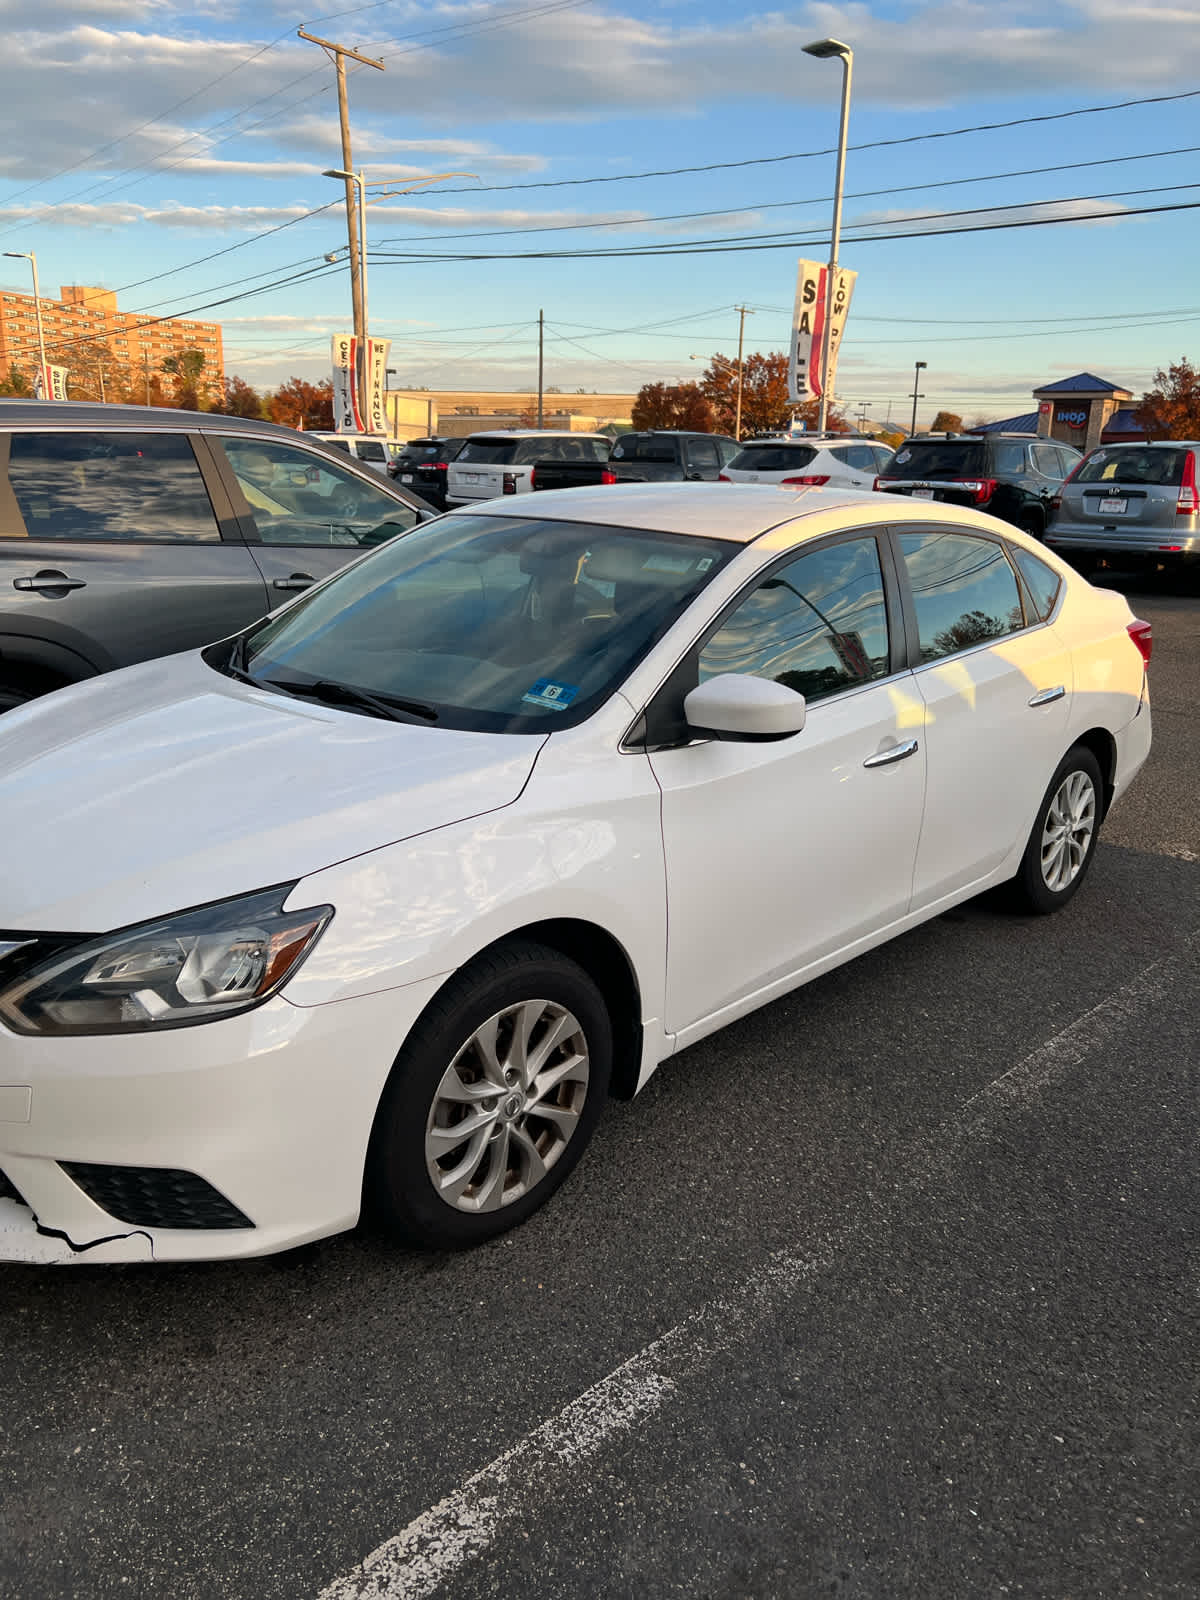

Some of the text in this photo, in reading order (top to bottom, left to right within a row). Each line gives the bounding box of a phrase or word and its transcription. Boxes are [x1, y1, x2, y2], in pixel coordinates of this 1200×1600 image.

[833, 277, 846, 315] LOW
[796, 279, 817, 395] SALE
[373, 344, 384, 430] WE FINANCE
[1057, 412, 1087, 424] IHOP
